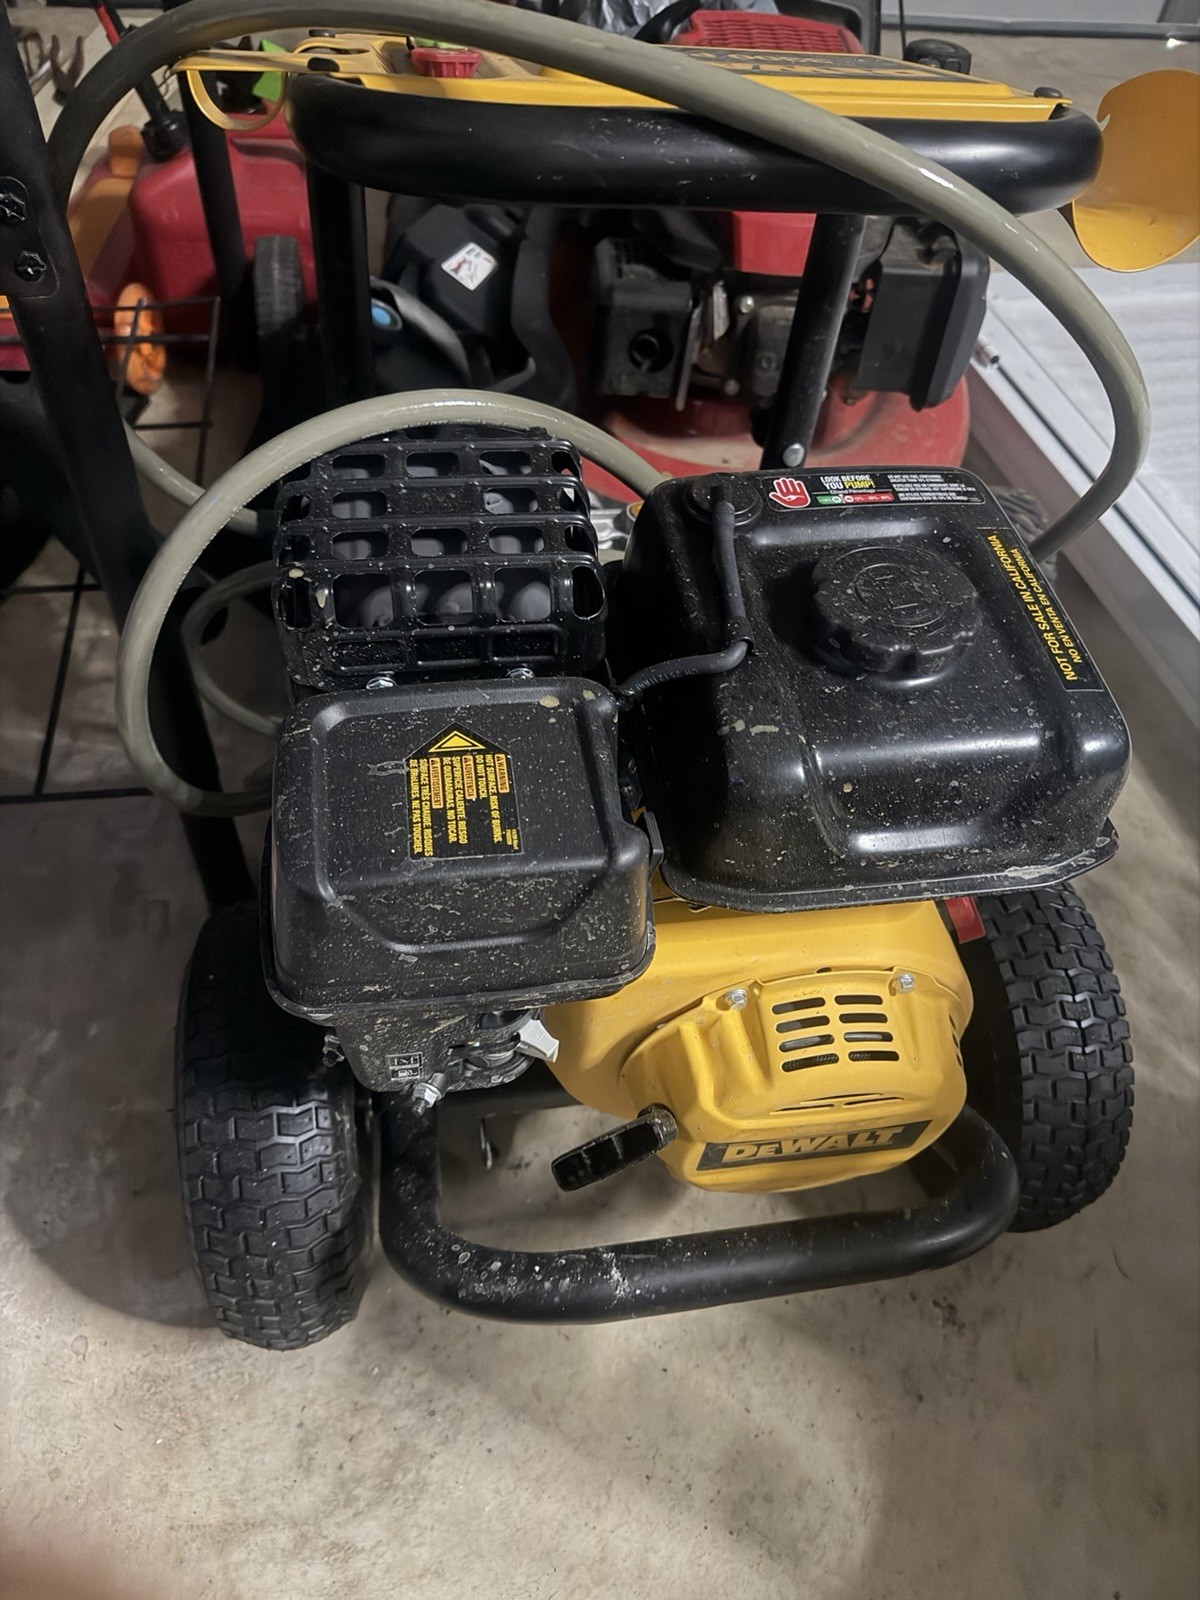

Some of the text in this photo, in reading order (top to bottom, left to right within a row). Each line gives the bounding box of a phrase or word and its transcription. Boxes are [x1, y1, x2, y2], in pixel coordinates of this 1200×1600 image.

[823, 481, 843, 489] YOU
[987, 535, 1077, 681] NOT FOR SALE IN CALIFORNIA
[1011, 549, 1082, 663] NO EN VENTA EN CALIFORNIA
[409, 759, 418, 768] DE
[476, 755, 484, 764] DO
[485, 754, 494, 766] HOT
[476, 764, 486, 777] NOT
[497, 762, 508, 791] WARNING
[432, 766, 441, 806] AVERTISSEMENT
[443, 757, 451, 765] DE
[447, 810, 455, 819] NO
[465, 764, 474, 797] ADVERTENCIA
[413, 800, 421, 809] NE
[419, 759, 429, 784] SURFACE
[424, 829, 433, 856] RISQUES
[490, 795, 498, 810] RISK
[412, 810, 421, 822] PAS
[491, 810, 499, 819] OF
[458, 821, 467, 844] RIESGO
[492, 819, 502, 843] BURNS.
